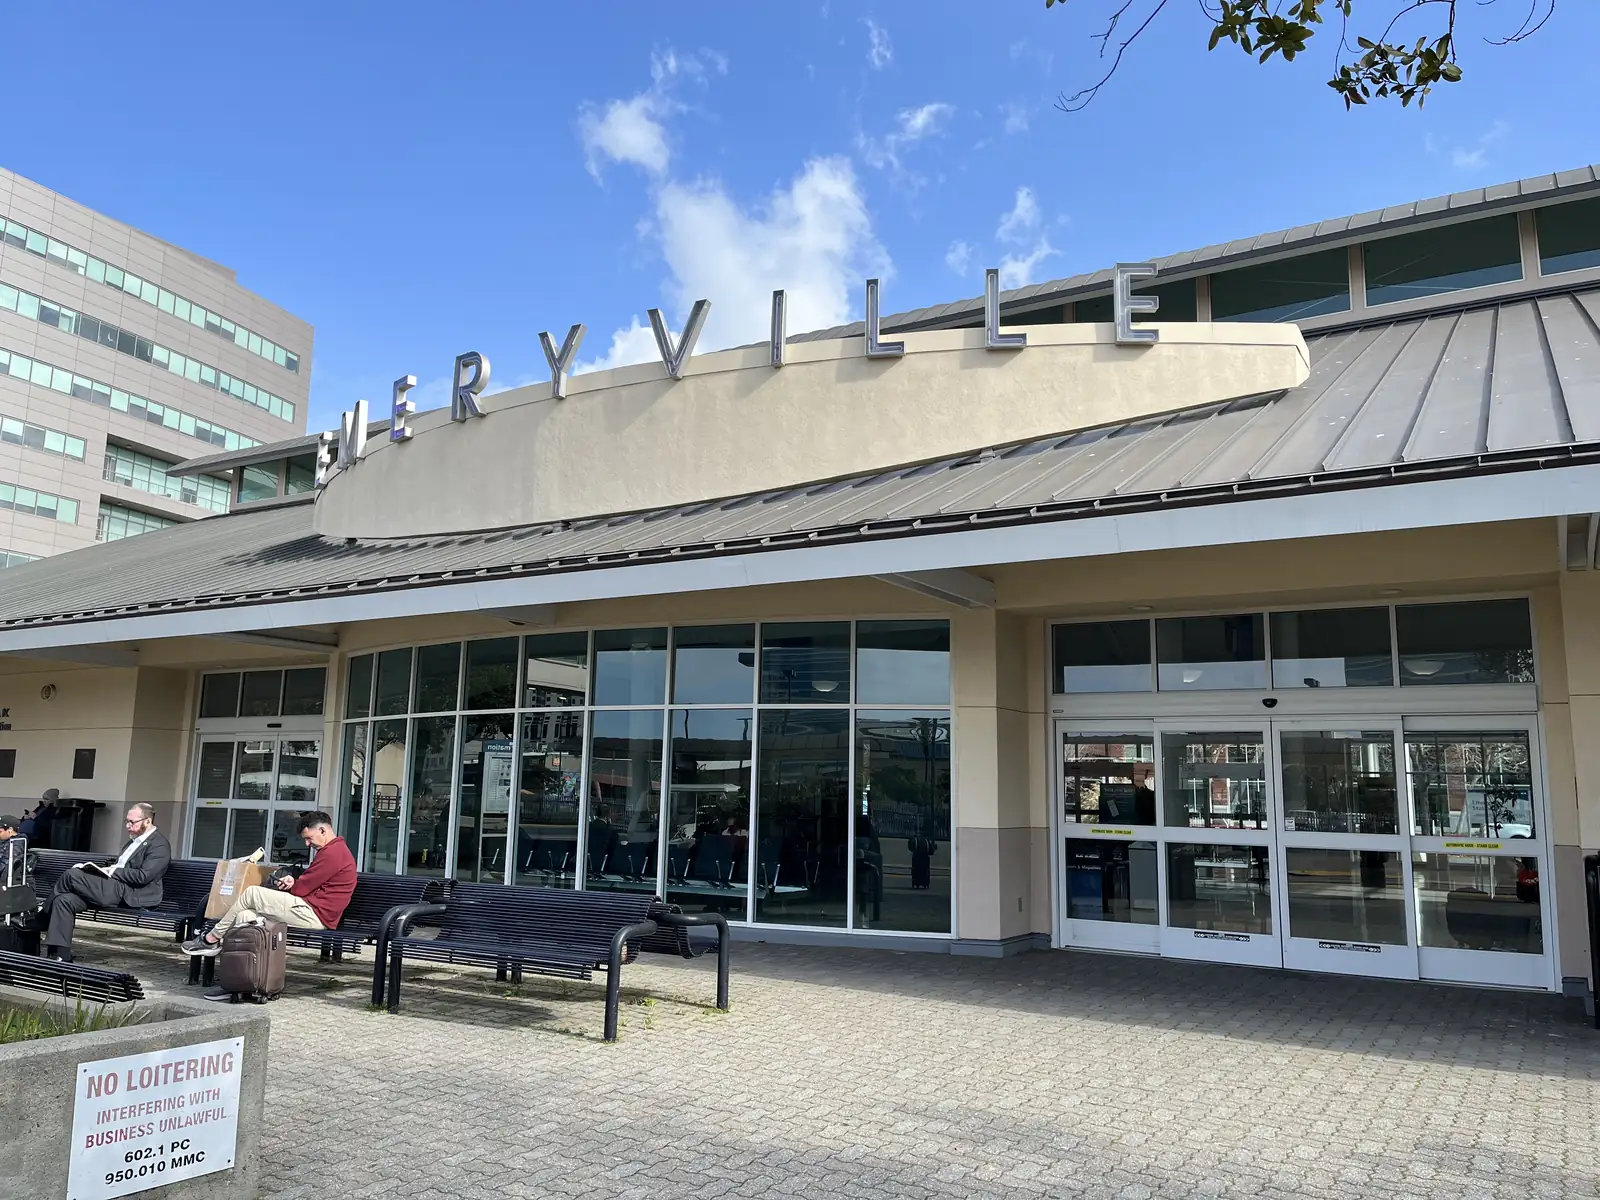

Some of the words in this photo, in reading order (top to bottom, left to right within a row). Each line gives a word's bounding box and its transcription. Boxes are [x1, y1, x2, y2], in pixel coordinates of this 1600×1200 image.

[314, 262, 1159, 490] EMERYVILLE
[86, 1072, 119, 1100] NO
[126, 1051, 234, 1092] LOITERING
[96, 1095, 185, 1125] INTERFERING
[189, 1088, 221, 1106] WITH
[85, 1122, 154, 1149] BUSINESS
[159, 1107, 227, 1132] UNLAWFUL
[104, 1160, 166, 1185] 950.010
[170, 1151, 206, 1169] MMC
[124, 1144, 164, 1163] 602.1
[171, 1138, 191, 1153] PC
